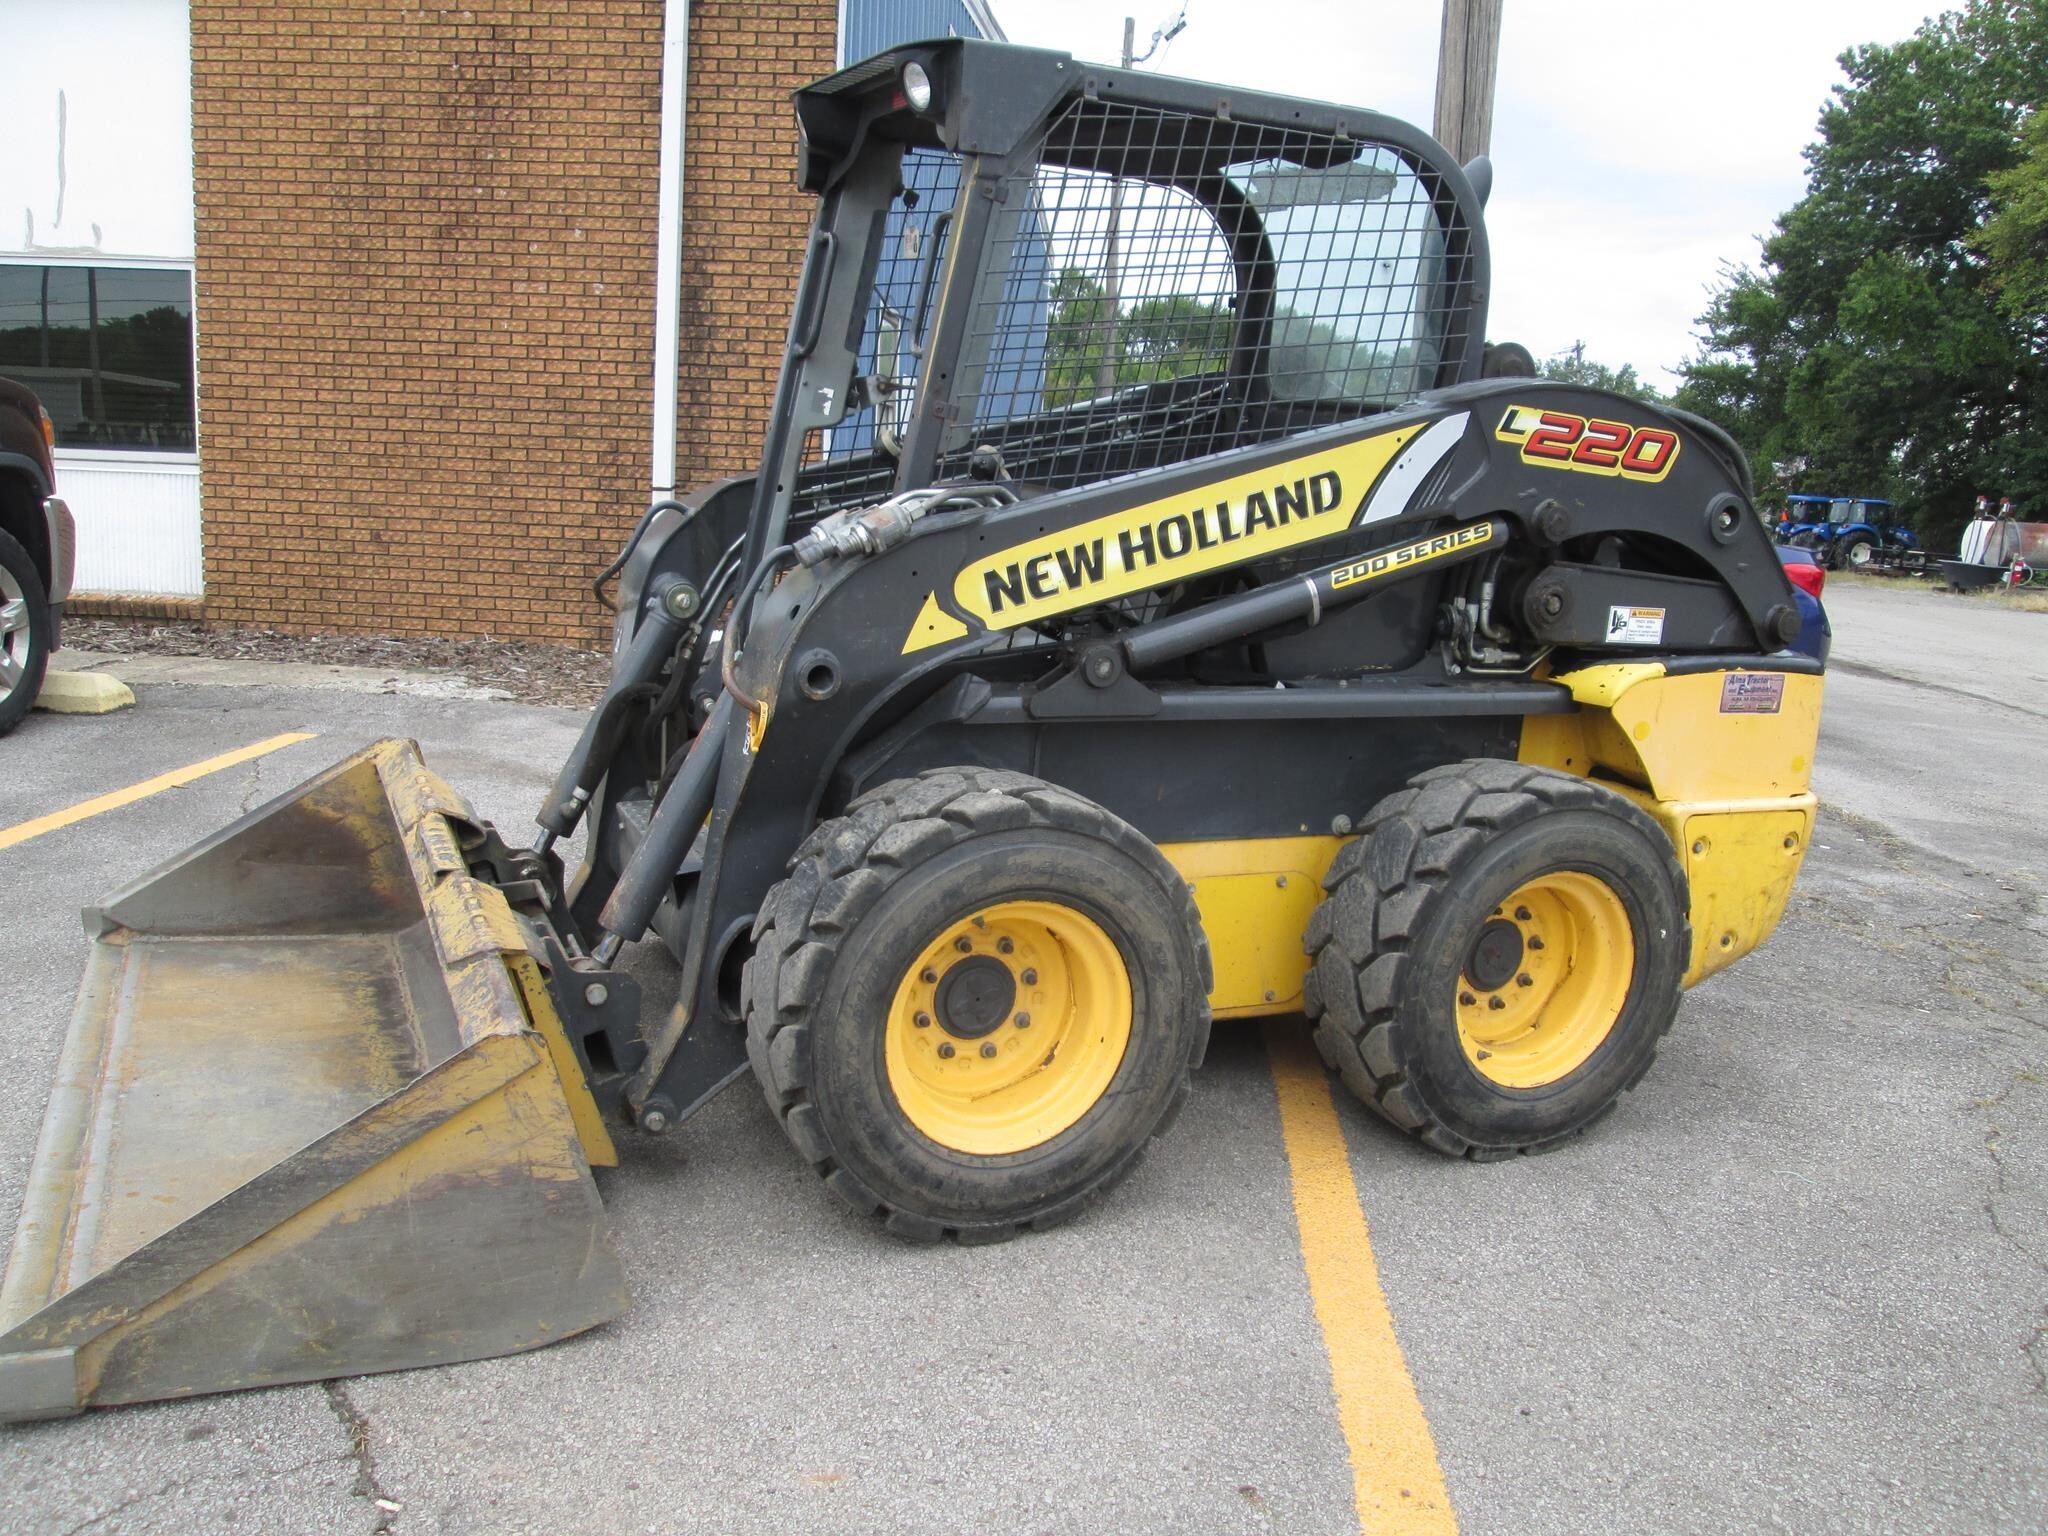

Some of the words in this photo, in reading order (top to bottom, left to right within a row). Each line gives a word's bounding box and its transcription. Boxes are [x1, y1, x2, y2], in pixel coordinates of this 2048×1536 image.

[1498, 408, 1678, 476] L220
[983, 537, 1107, 614] NEW
[1118, 469, 1344, 572] HOLLAND
[1333, 555, 1389, 585] 200
[1396, 523, 1490, 565] SERIES
